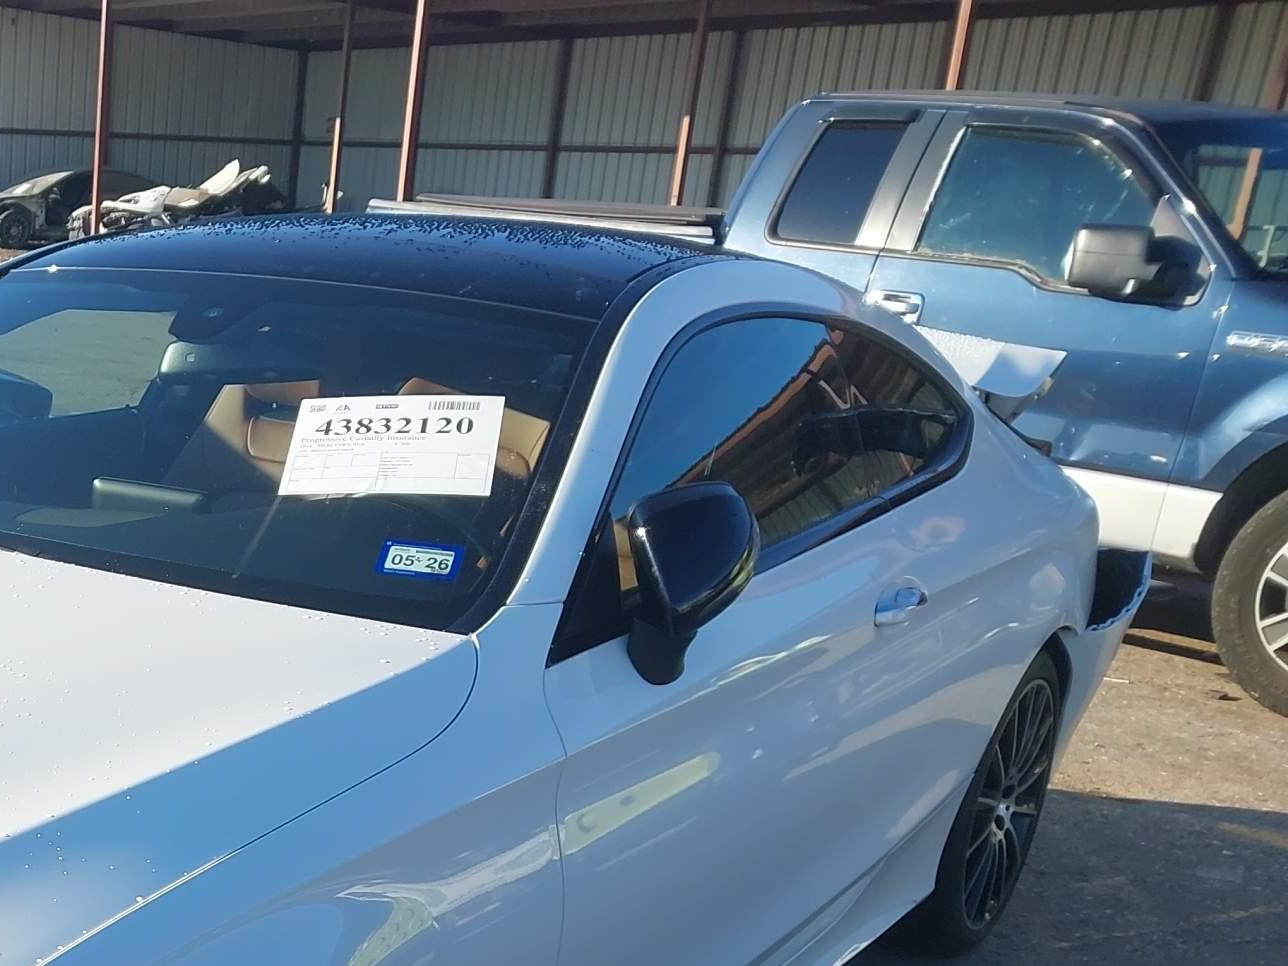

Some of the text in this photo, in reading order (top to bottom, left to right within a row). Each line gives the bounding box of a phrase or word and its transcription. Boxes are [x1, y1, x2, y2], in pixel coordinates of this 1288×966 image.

[315, 417, 474, 436] 43832120
[391, 554, 416, 567] 05
[425, 557, 451, 571] 26
